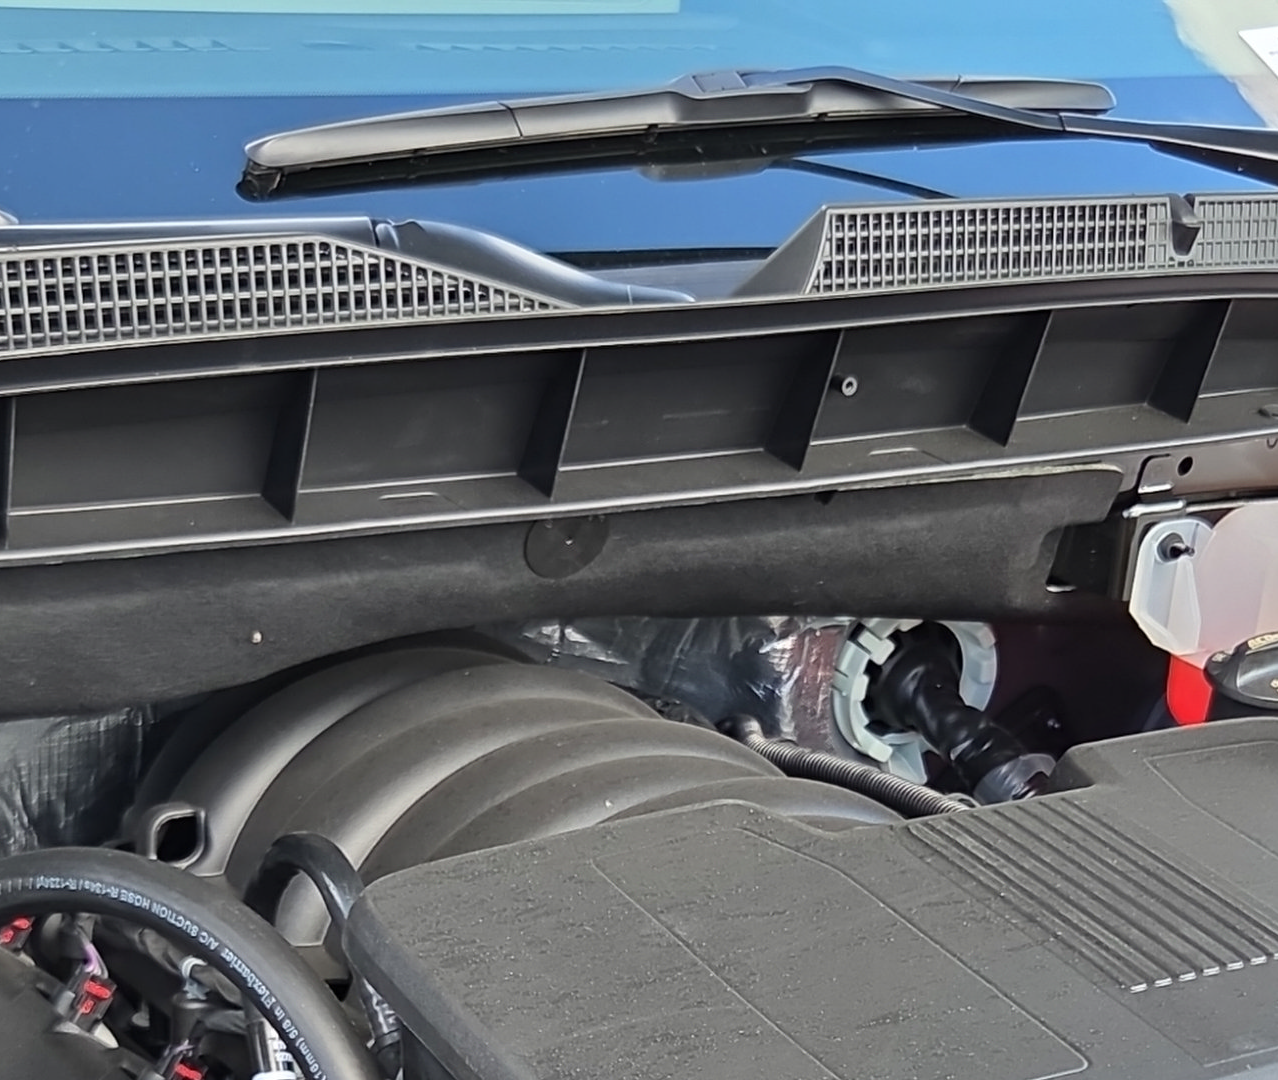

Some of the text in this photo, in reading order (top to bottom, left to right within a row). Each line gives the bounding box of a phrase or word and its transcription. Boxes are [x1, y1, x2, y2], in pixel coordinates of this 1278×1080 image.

[84, 879, 119, 899] R-134a
[119, 889, 151, 911] HOSE
[152, 902, 200, 937] SUCTION
[199, 931, 220, 951] A/C
[220, 947, 277, 1010] Flexbarrier
[281, 1018, 299, 1040] 5/8
